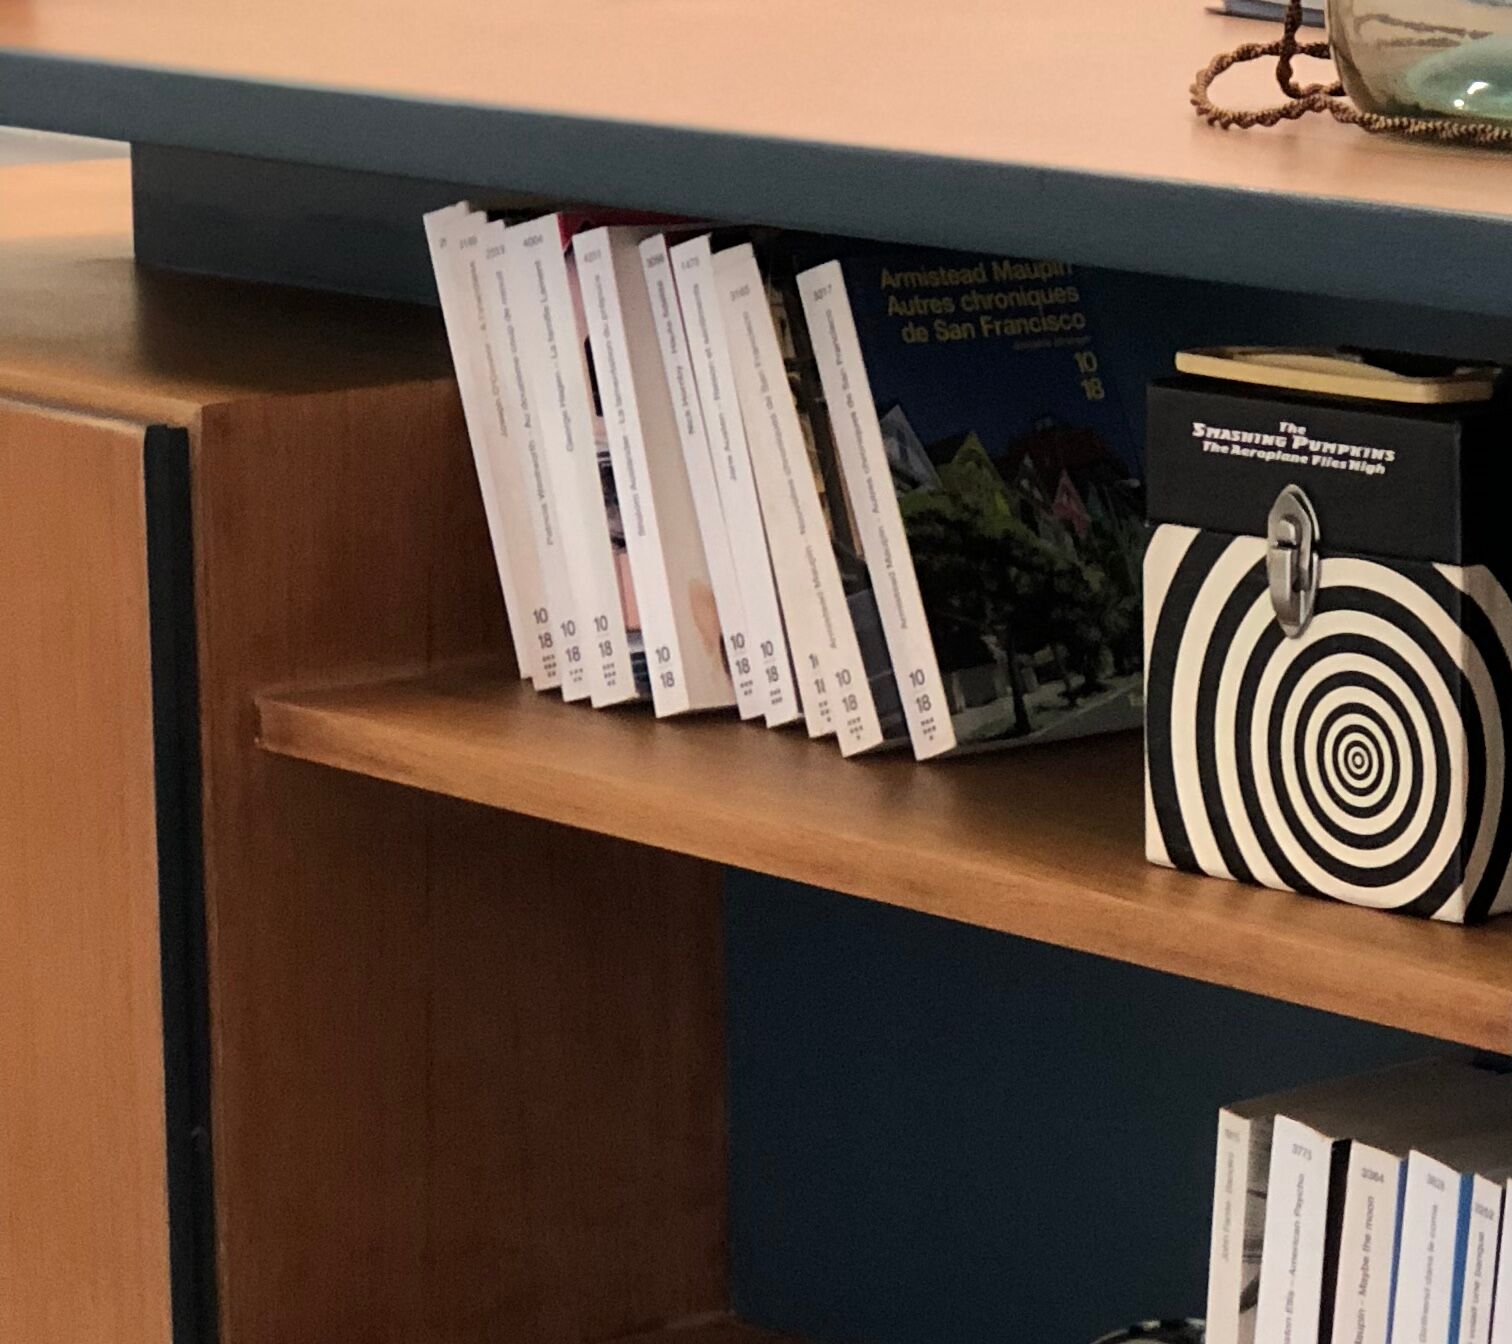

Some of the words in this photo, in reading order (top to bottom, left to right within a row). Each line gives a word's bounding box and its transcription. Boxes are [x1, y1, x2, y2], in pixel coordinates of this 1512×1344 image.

[880, 263, 985, 289] Armistead
[888, 296, 955, 316] Autres
[961, 286, 1080, 315] chroniques
[902, 322, 929, 344] de
[935, 319, 976, 342] San
[980, 312, 1087, 338] Francisco
[1074, 351, 1098, 374] 10
[1081, 377, 1105, 401] 18
[1280, 421, 1307, 435] The
[1202, 440, 1229, 454] The
[1230, 444, 1308, 464] Aeroplane
[1348, 459, 1386, 476] High
[533, 607, 548, 625] 10
[594, 615, 609, 632] 10
[561, 620, 576, 638] 10
[538, 632, 553, 650] 18
[598, 640, 613, 658] 18
[730, 632, 745, 650] 10
[760, 640, 774, 657] 10
[566, 646, 581, 664] 18
[655, 646, 670, 663] 10
[735, 658, 750, 675] 18
[765, 666, 779, 683] 18
[660, 671, 675, 689] 18
[835, 669, 851, 687] 10
[909, 669, 925, 688] 10
[842, 694, 858, 713] 18
[915, 694, 932, 713] 18
[1293, 1173, 1305, 1217] Psycho
[1288, 1219, 1301, 1277] American
[1357, 1255, 1370, 1297] Maybe
[1365, 1195, 1374, 1230] moon
